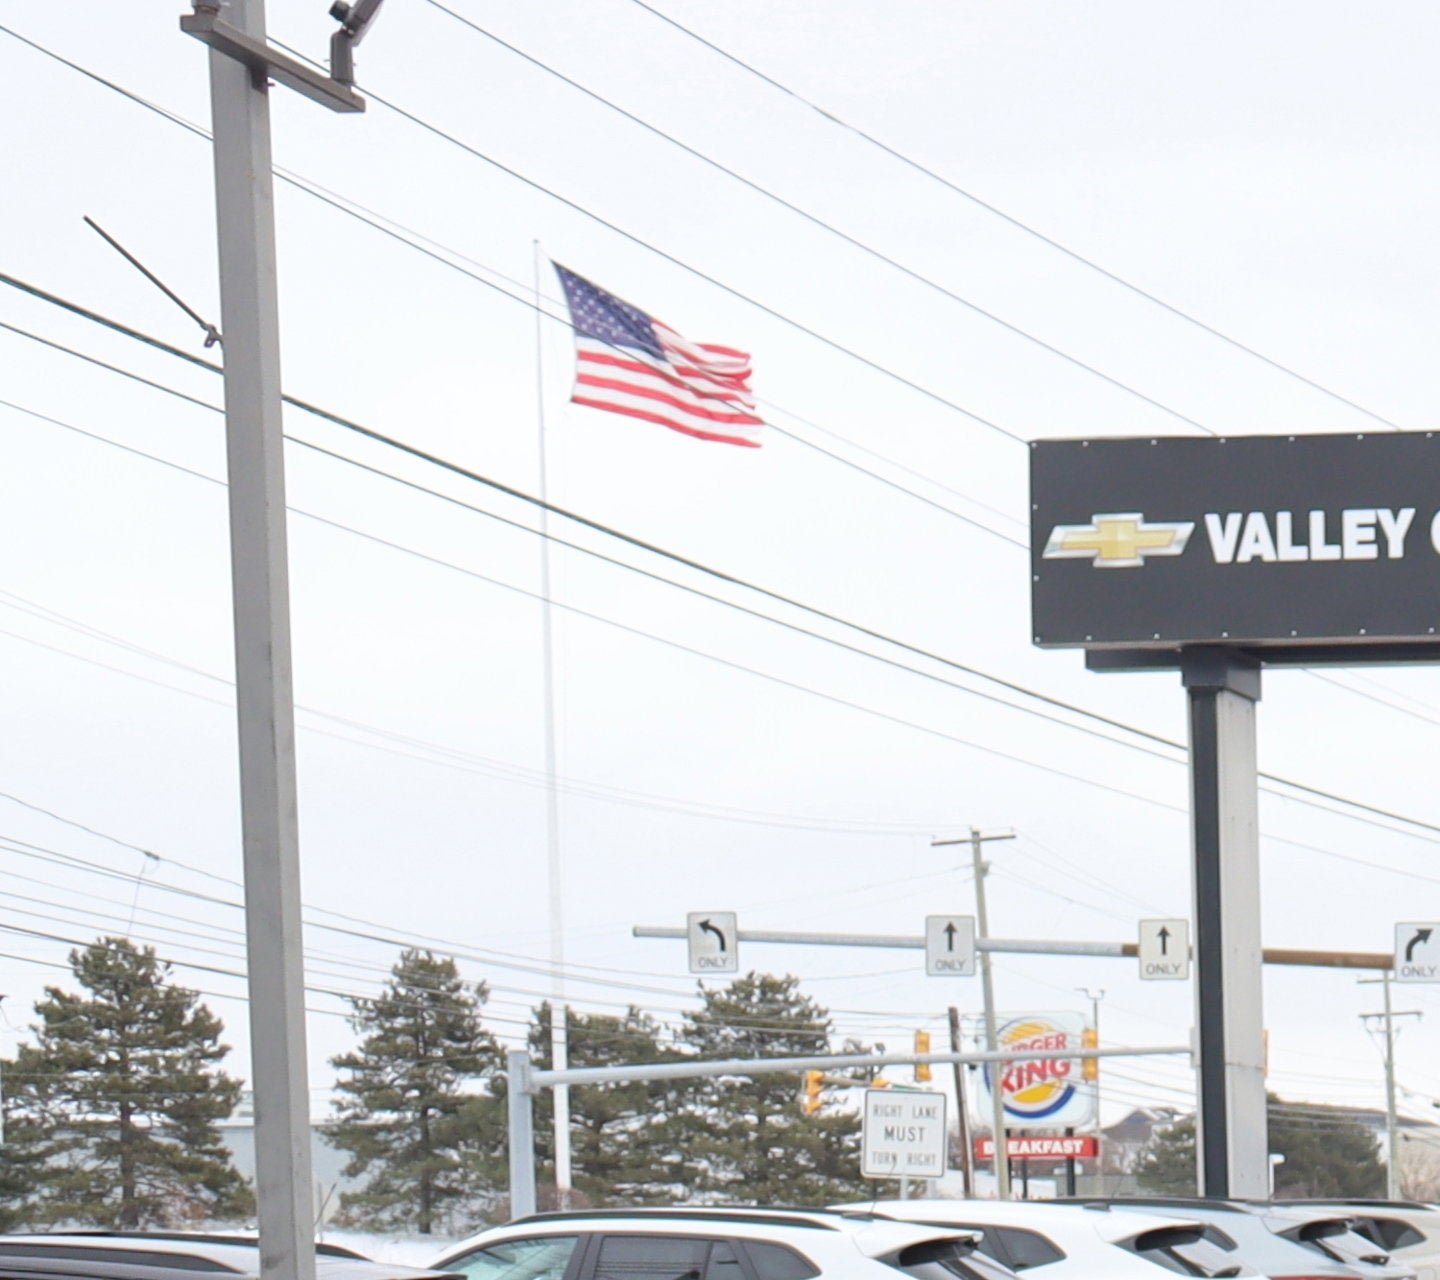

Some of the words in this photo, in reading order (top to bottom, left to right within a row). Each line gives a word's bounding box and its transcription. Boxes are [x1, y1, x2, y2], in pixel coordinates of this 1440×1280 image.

[1204, 507, 1416, 563] VALLEY
[698, 956, 728, 968] ONLY
[934, 958, 966, 972] ONLY
[1146, 962, 1182, 975] ONLY
[1401, 965, 1438, 978] ONLY
[873, 1104, 902, 1117] RIGHT
[912, 1106, 938, 1119] LANE
[884, 1126, 926, 1142] MUST
[983, 1139, 1084, 1155] BEAKFAST
[872, 1151, 898, 1164] TURN
[907, 1153, 936, 1166] RIGHT
